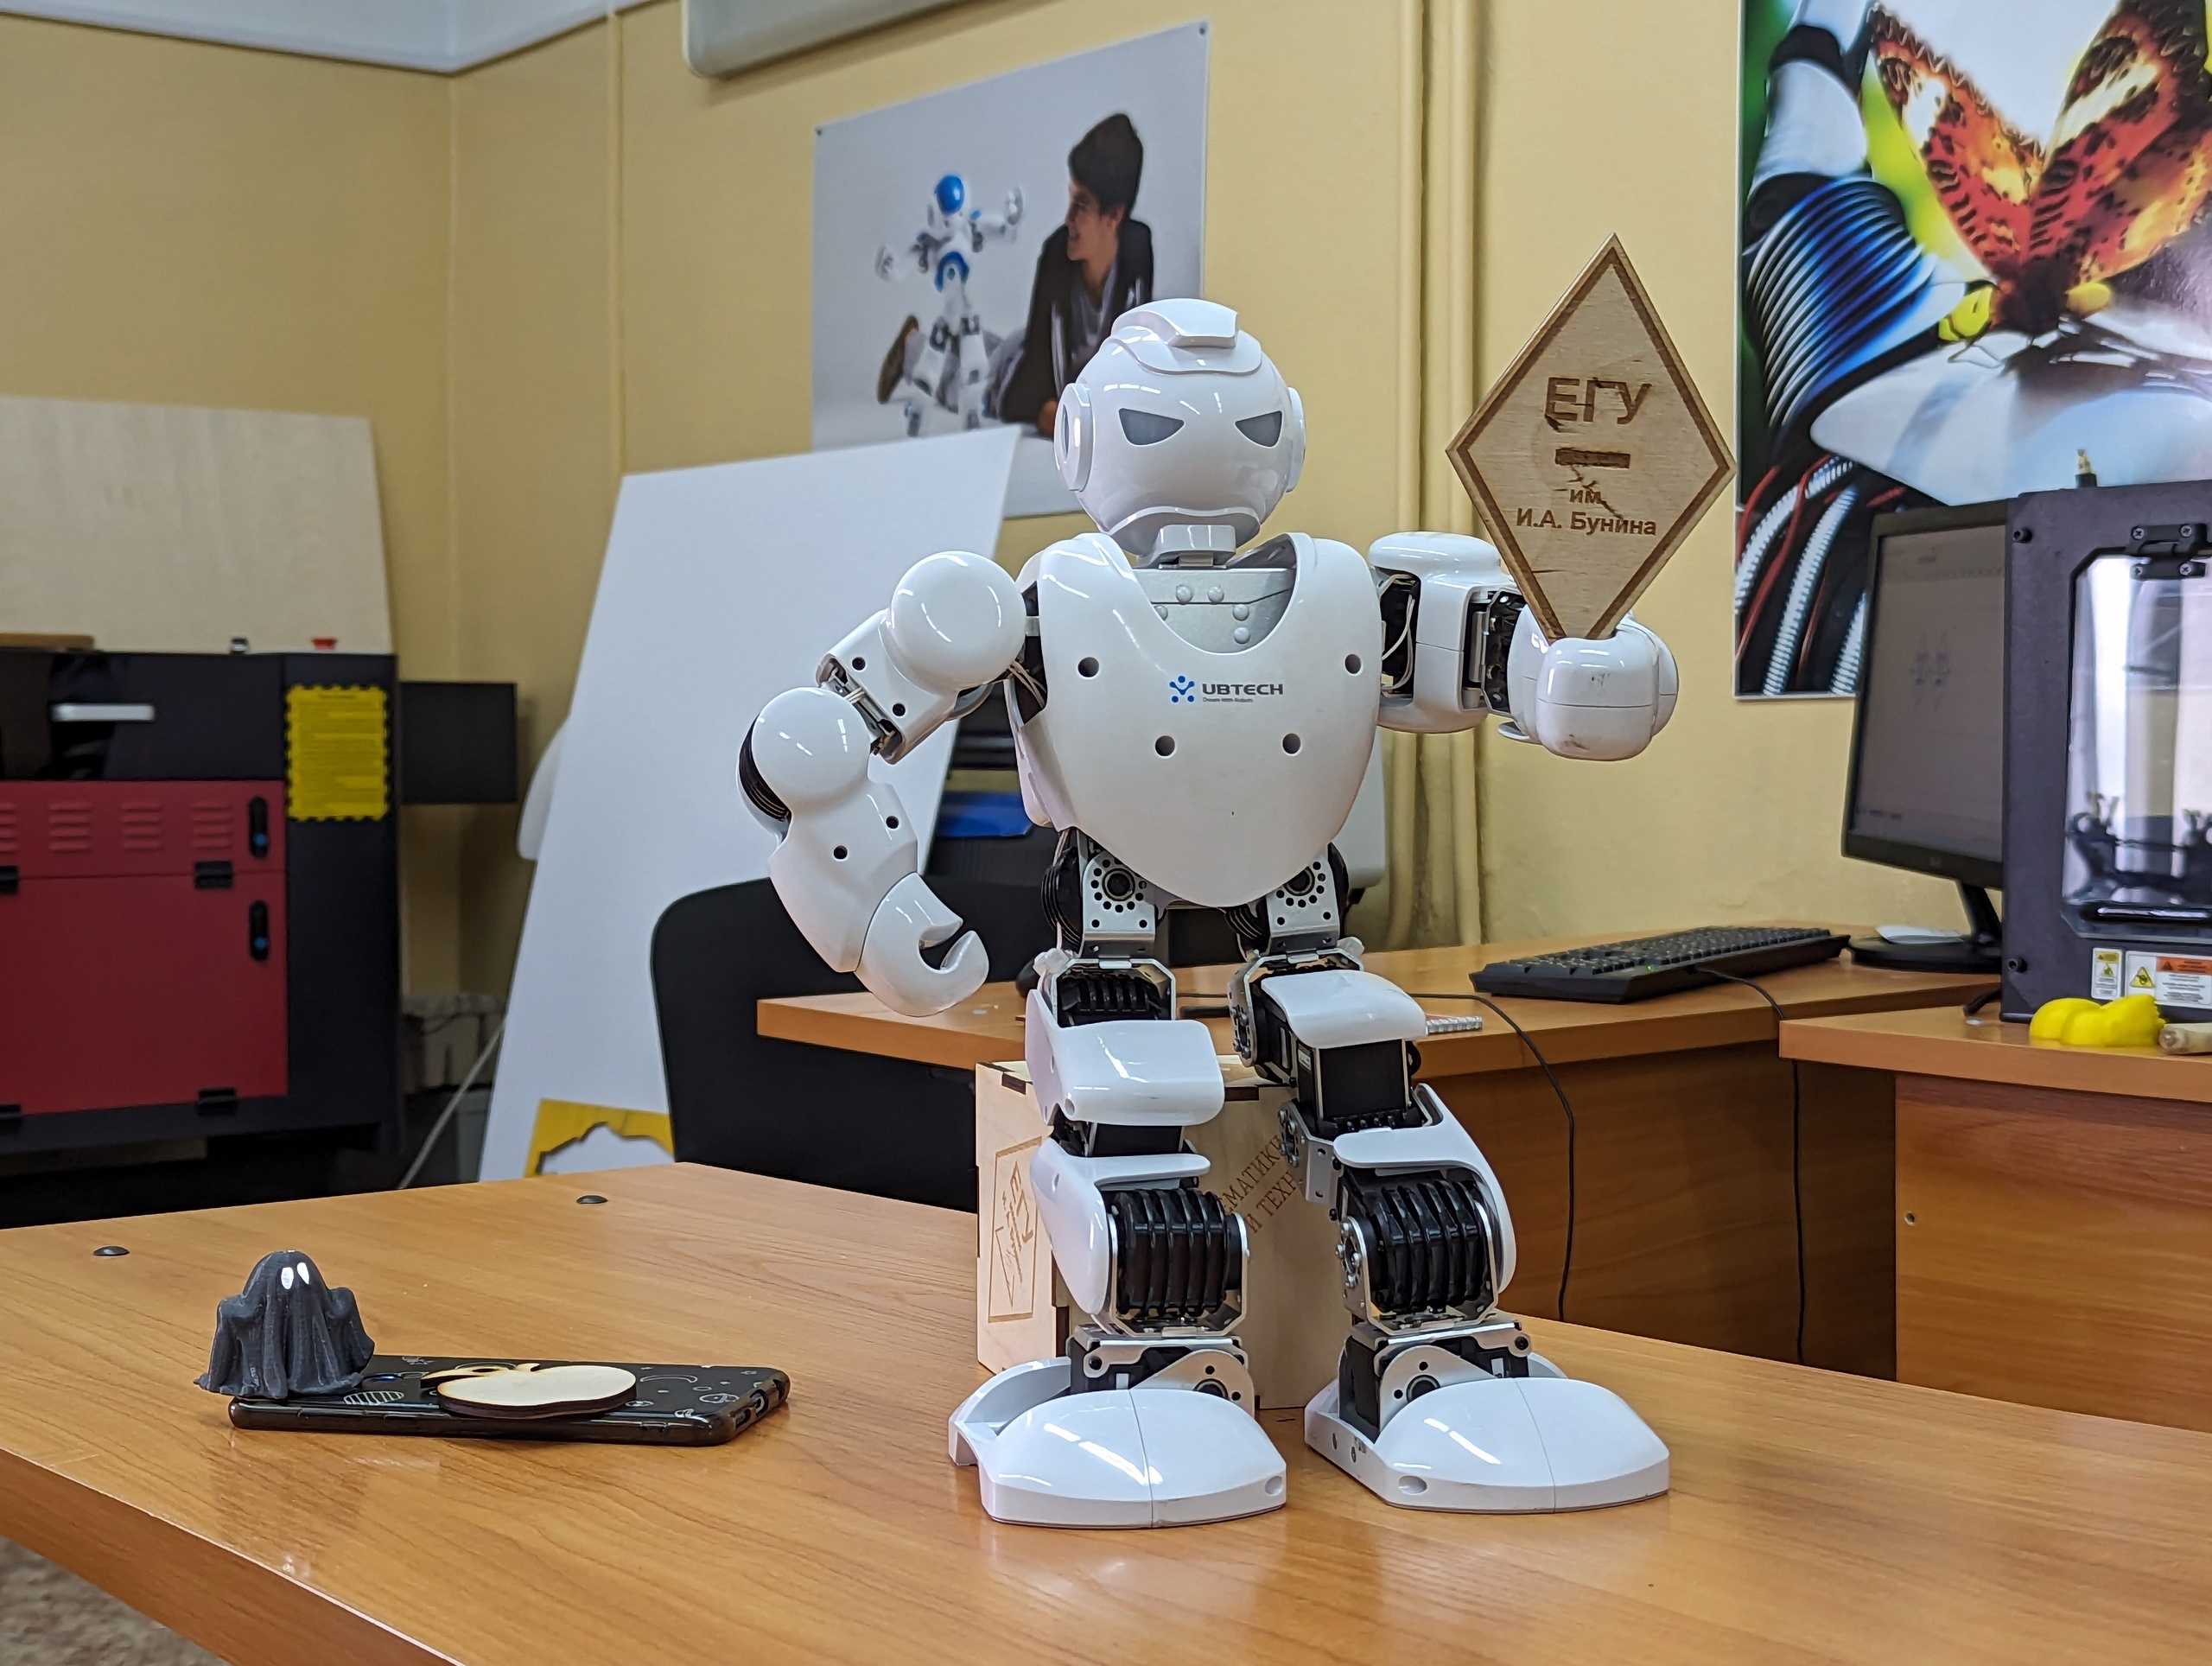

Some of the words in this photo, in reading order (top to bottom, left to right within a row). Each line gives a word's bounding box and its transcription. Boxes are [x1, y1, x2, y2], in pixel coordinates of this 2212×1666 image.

[1545, 377, 1652, 425] ЕГУ
[1516, 507, 1562, 529] И.А.
[1570, 511, 1656, 536] Бунина
[1202, 684, 1284, 696] UBTECH
[1245, 1213, 1262, 1234] И
